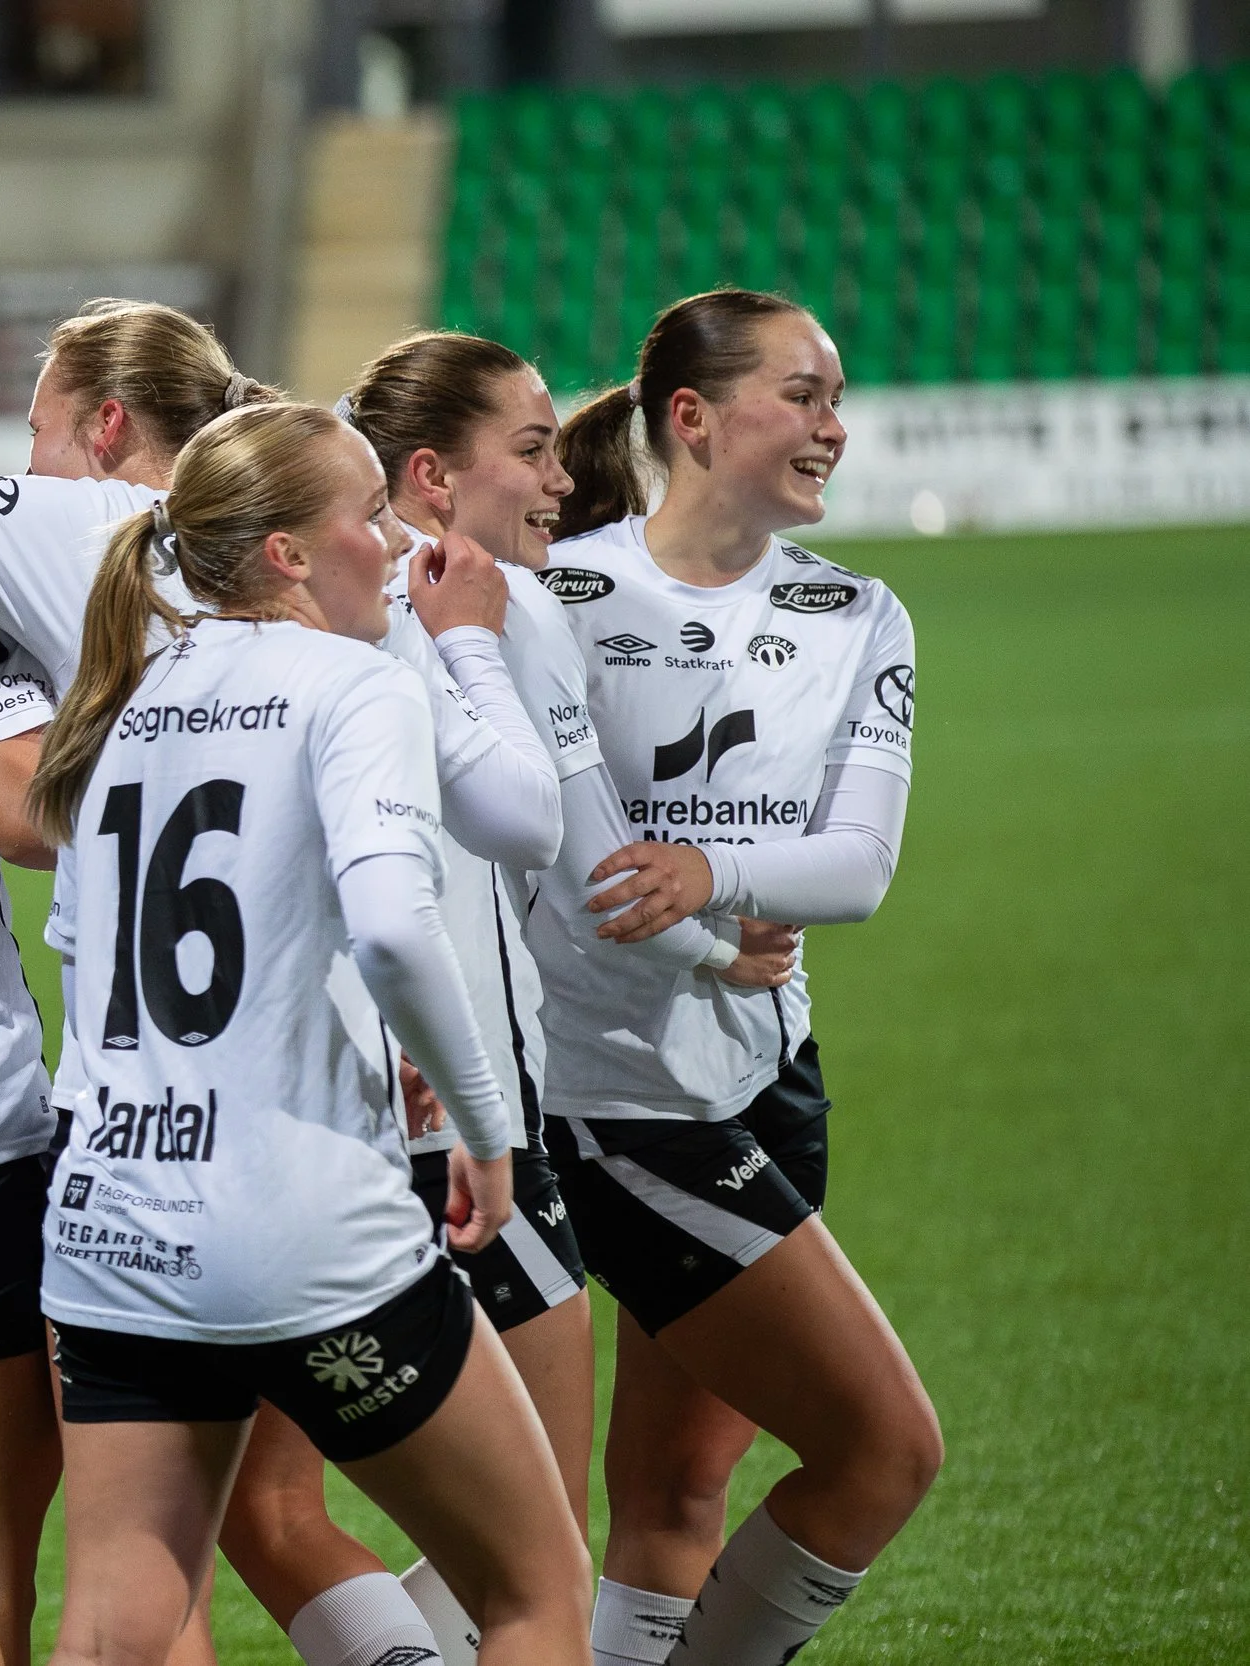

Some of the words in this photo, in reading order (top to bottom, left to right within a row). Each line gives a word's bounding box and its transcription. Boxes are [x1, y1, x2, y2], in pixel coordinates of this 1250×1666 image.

[537, 570, 606, 601] Lerum
[771, 585, 849, 611] Lerum
[749, 636, 792, 654] SOGNDAL
[605, 655, 652, 667] umbro
[665, 656, 735, 671] Statkraft
[119, 695, 290, 743] Sognekraft
[847, 720, 907, 750] Toyota
[97, 778, 247, 1051] 16
[97, 1183, 205, 1215] FAGFORBUNDET
[55, 1241, 168, 1275] KREFTTRÅKK
[336, 1364, 420, 1423] mesta
